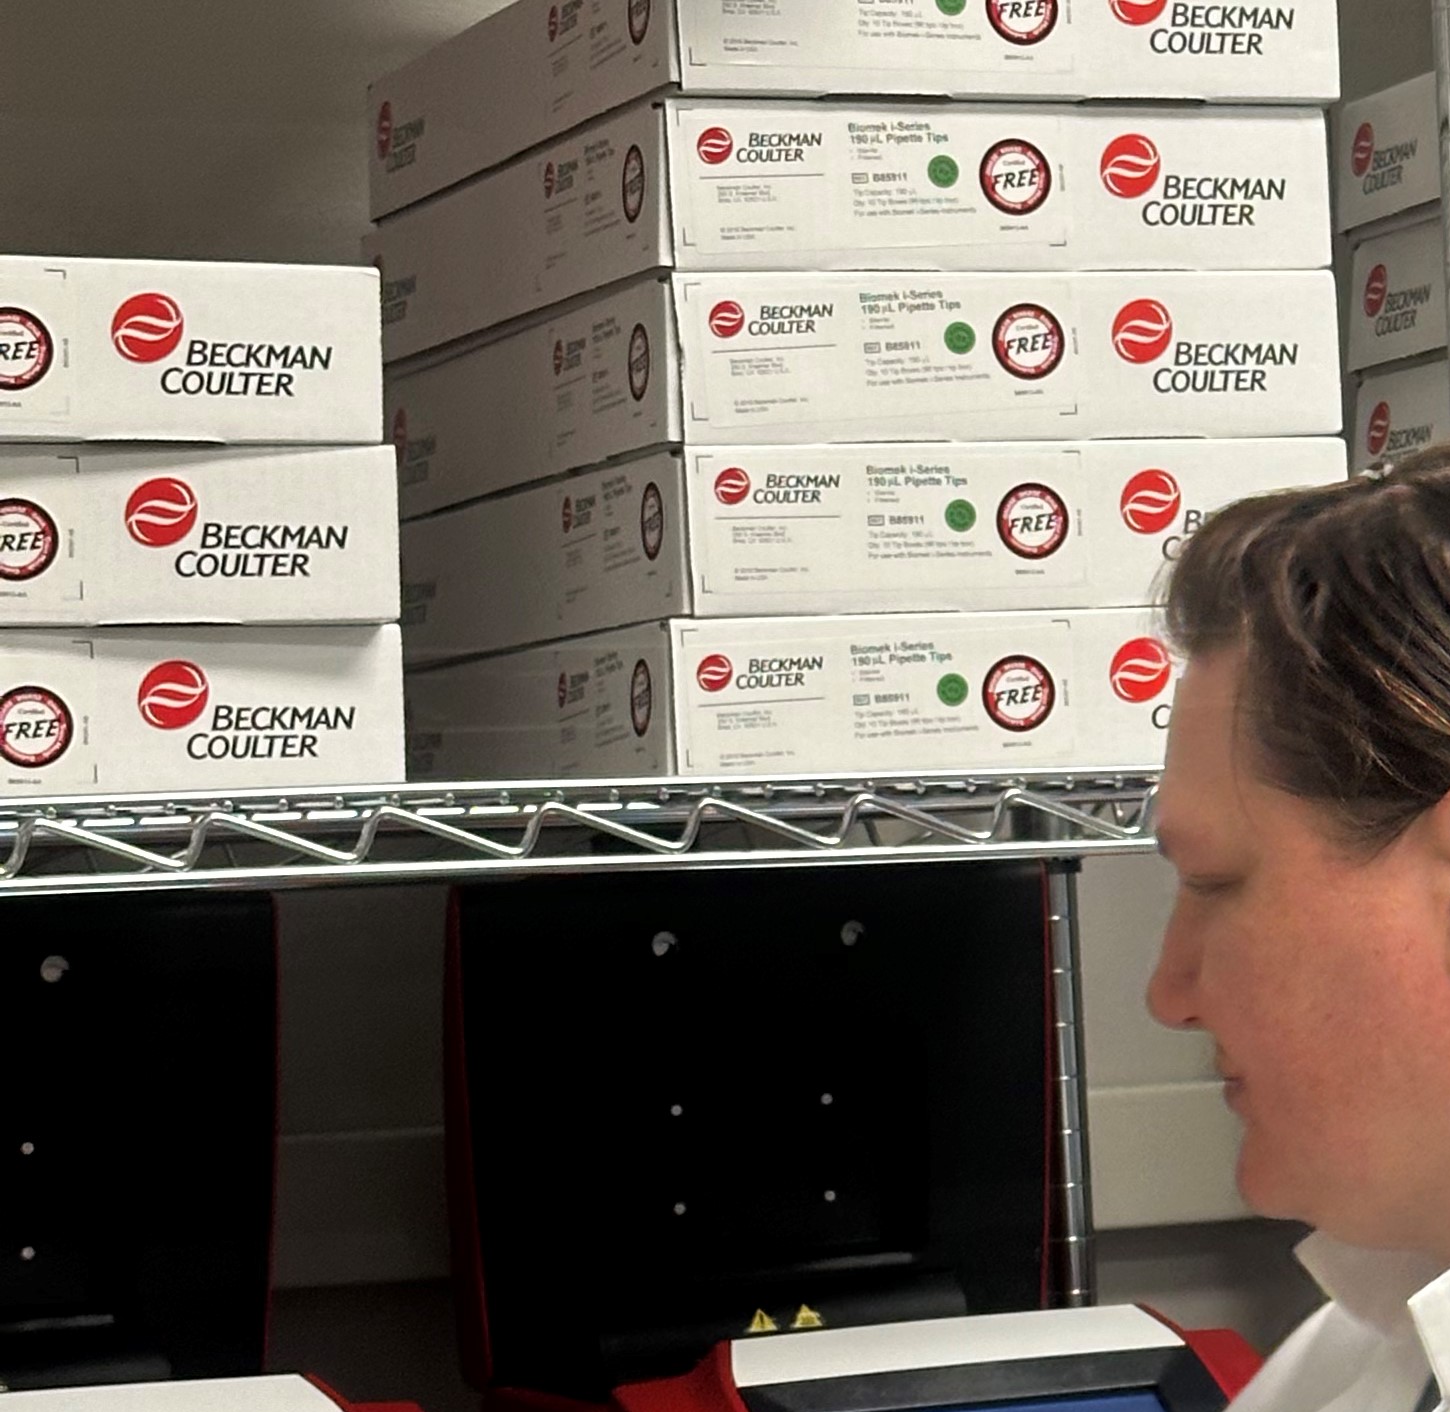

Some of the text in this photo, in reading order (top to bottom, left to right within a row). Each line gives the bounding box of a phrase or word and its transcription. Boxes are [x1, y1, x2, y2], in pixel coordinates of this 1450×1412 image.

[1171, 2, 1295, 30] BECKMAN
[1150, 28, 1264, 55] COULTER
[748, 132, 822, 147] BECKMAN
[736, 147, 804, 163] COULTER
[992, 168, 1039, 191] FREE
[1163, 175, 1286, 200] BECKMAN
[1142, 201, 1256, 227] COULTER
[760, 303, 834, 320] BECKMAN
[747, 319, 816, 336] COULTER
[186, 339, 332, 370] BECKMAN
[1005, 332, 1052, 356] FREE
[1173, 341, 1298, 366] BECKMAN
[160, 367, 295, 397] COULTER
[1152, 368, 1267, 393] COULTER
[765, 473, 841, 489] BECKMAN
[753, 489, 821, 505] COULTER
[200, 522, 348, 550] BECKMAN
[1008, 512, 1057, 536] FREE
[0, 531, 46, 552] REE
[174, 550, 310, 578] COULTER
[748, 656, 824, 672] BECKMAN
[736, 672, 805, 690] COULTER
[995, 684, 1043, 707] FREE
[2, 717, 60, 739] FREE
[211, 704, 356, 732] BECKMAN
[186, 733, 319, 759] COULTER
